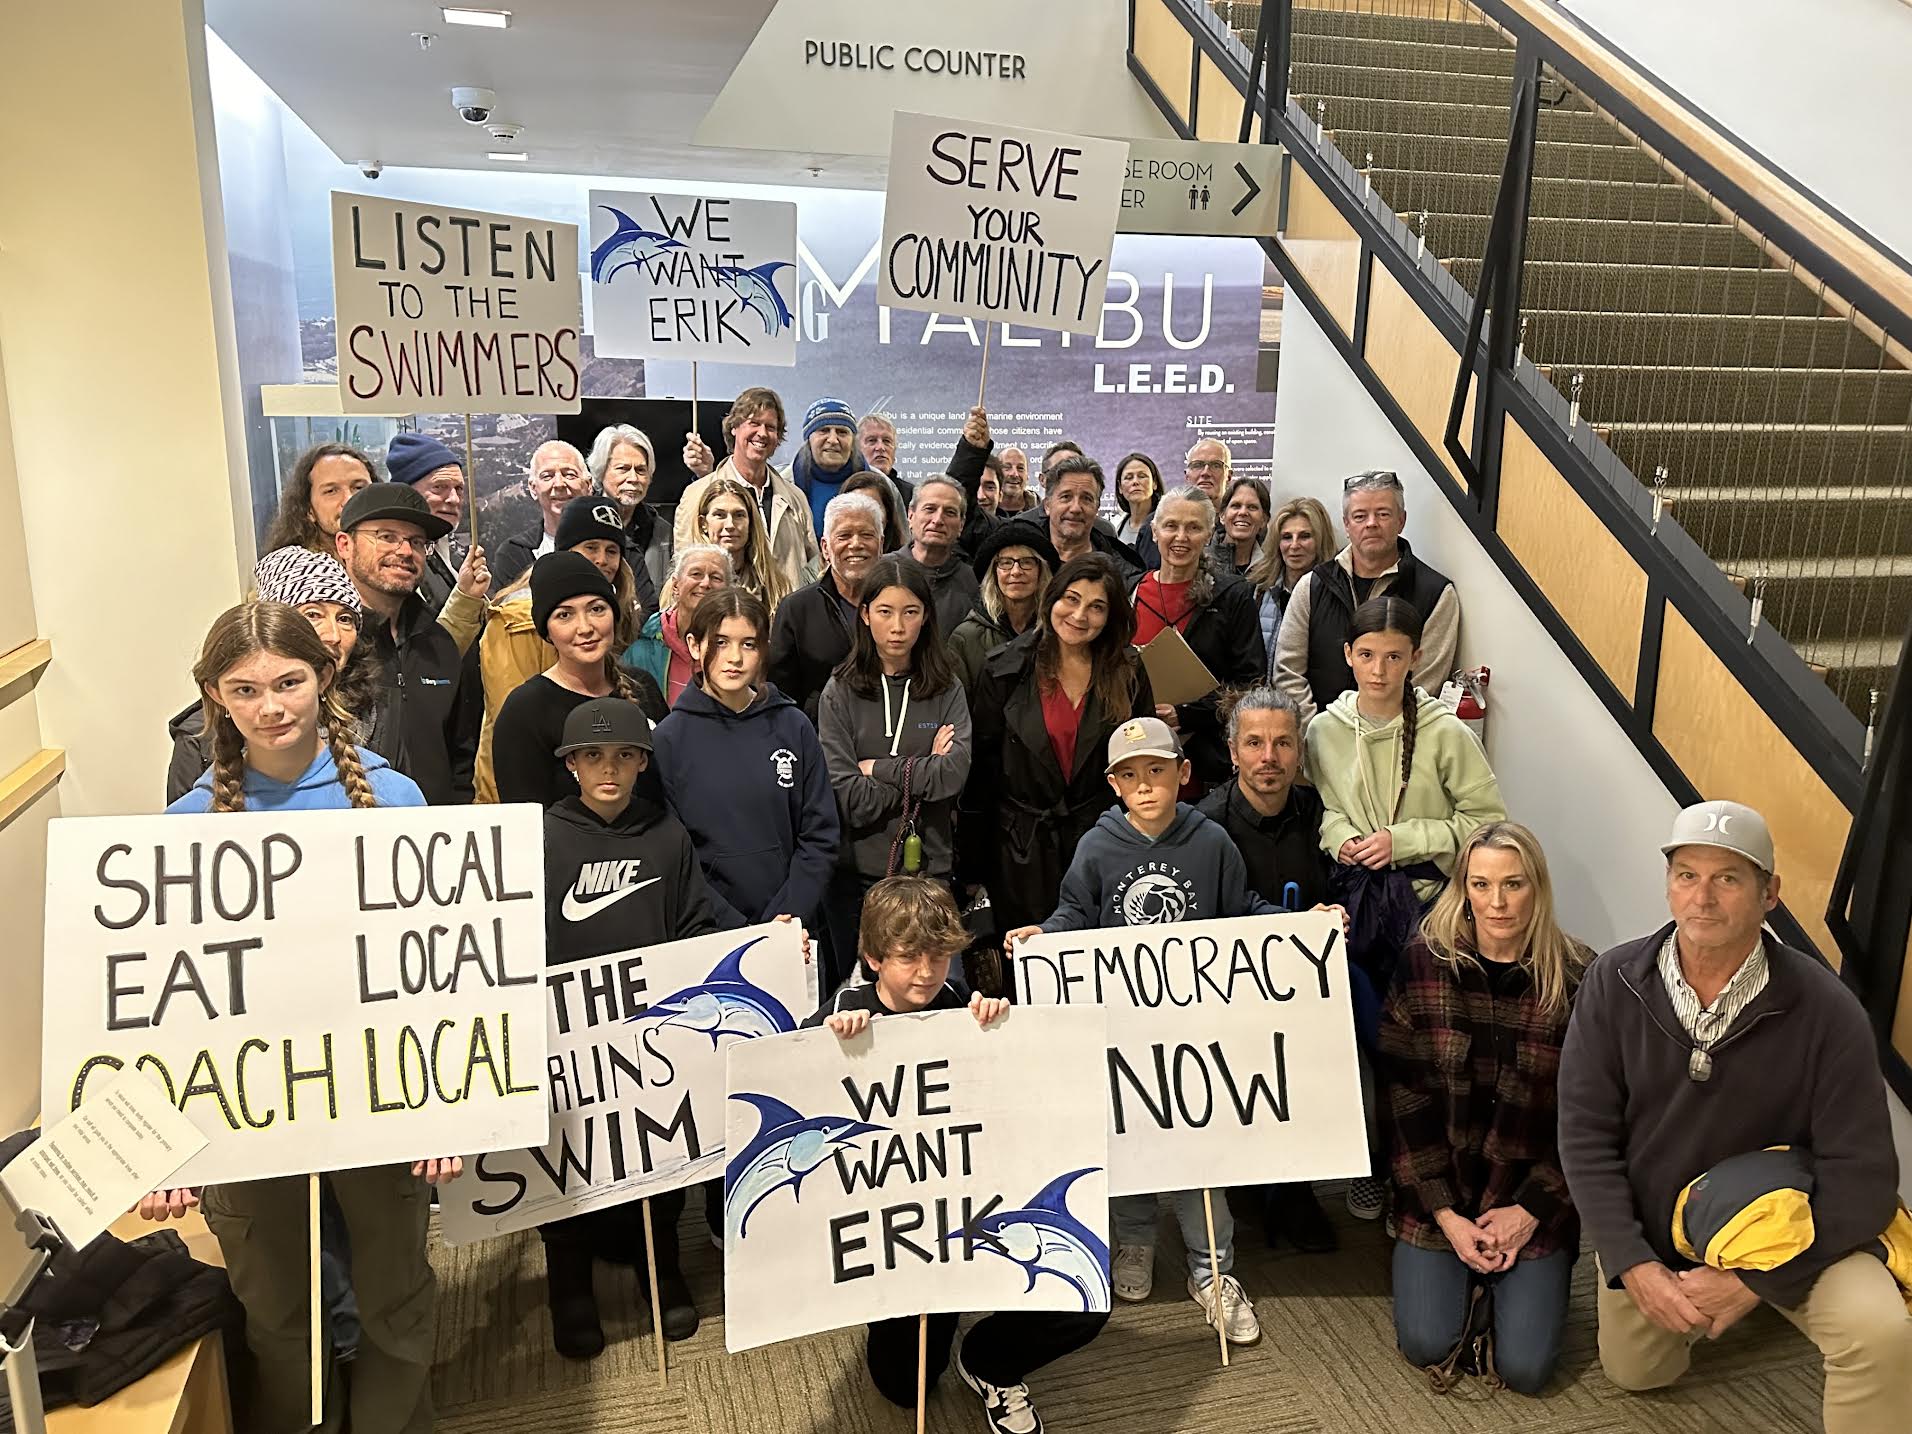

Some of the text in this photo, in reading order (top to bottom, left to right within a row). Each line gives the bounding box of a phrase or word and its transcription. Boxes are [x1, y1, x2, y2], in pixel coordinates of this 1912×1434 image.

[805, 40, 1026, 79] PUBLIC COUNTER
[926, 132, 1082, 201] SERVE
[1148, 160, 1213, 181] ROOM
[352, 205, 556, 282] LISTEN
[650, 195, 731, 243] WE
[967, 204, 1044, 247] YOUR
[639, 251, 745, 290] WANT
[796, 235, 1214, 350] MALBU
[889, 233, 1103, 321] COMMUNITY
[378, 281, 520, 320] TO THE
[650, 297, 751, 347] ERIK
[349, 325, 579, 402] SWIMMERS
[1093, 363, 1236, 394] L.E.E.D.
[900, 412, 908, 420] is
[919, 412, 945, 422] unique
[948, 411, 966, 420] land
[986, 412, 1064, 420] marine environment
[1011, 427, 1041, 435] citizens
[1043, 427, 1063, 435] have
[1186, 416, 1213, 425] SITE
[902, 456, 917, 464] and
[1020, 441, 1028, 449] to
[906, 470, 922, 478] that
[592, 708, 612, 733] LA
[94, 825, 533, 930] SHOP LOCAL
[574, 859, 641, 896] NIKE
[1112, 861, 1198, 914] MONTEREY BAY
[106, 918, 538, 1031] EAT LOCAL
[1019, 928, 1339, 1008] DEMOCRACY
[546, 956, 649, 1035] THE
[363, 1013, 540, 1114] LOCAL
[1106, 1031, 1291, 1135] NOW
[841, 1059, 951, 1123] WE
[471, 1089, 702, 1216] SWIM
[833, 1123, 983, 1195] WANT
[829, 1194, 1010, 1284] ERIK
